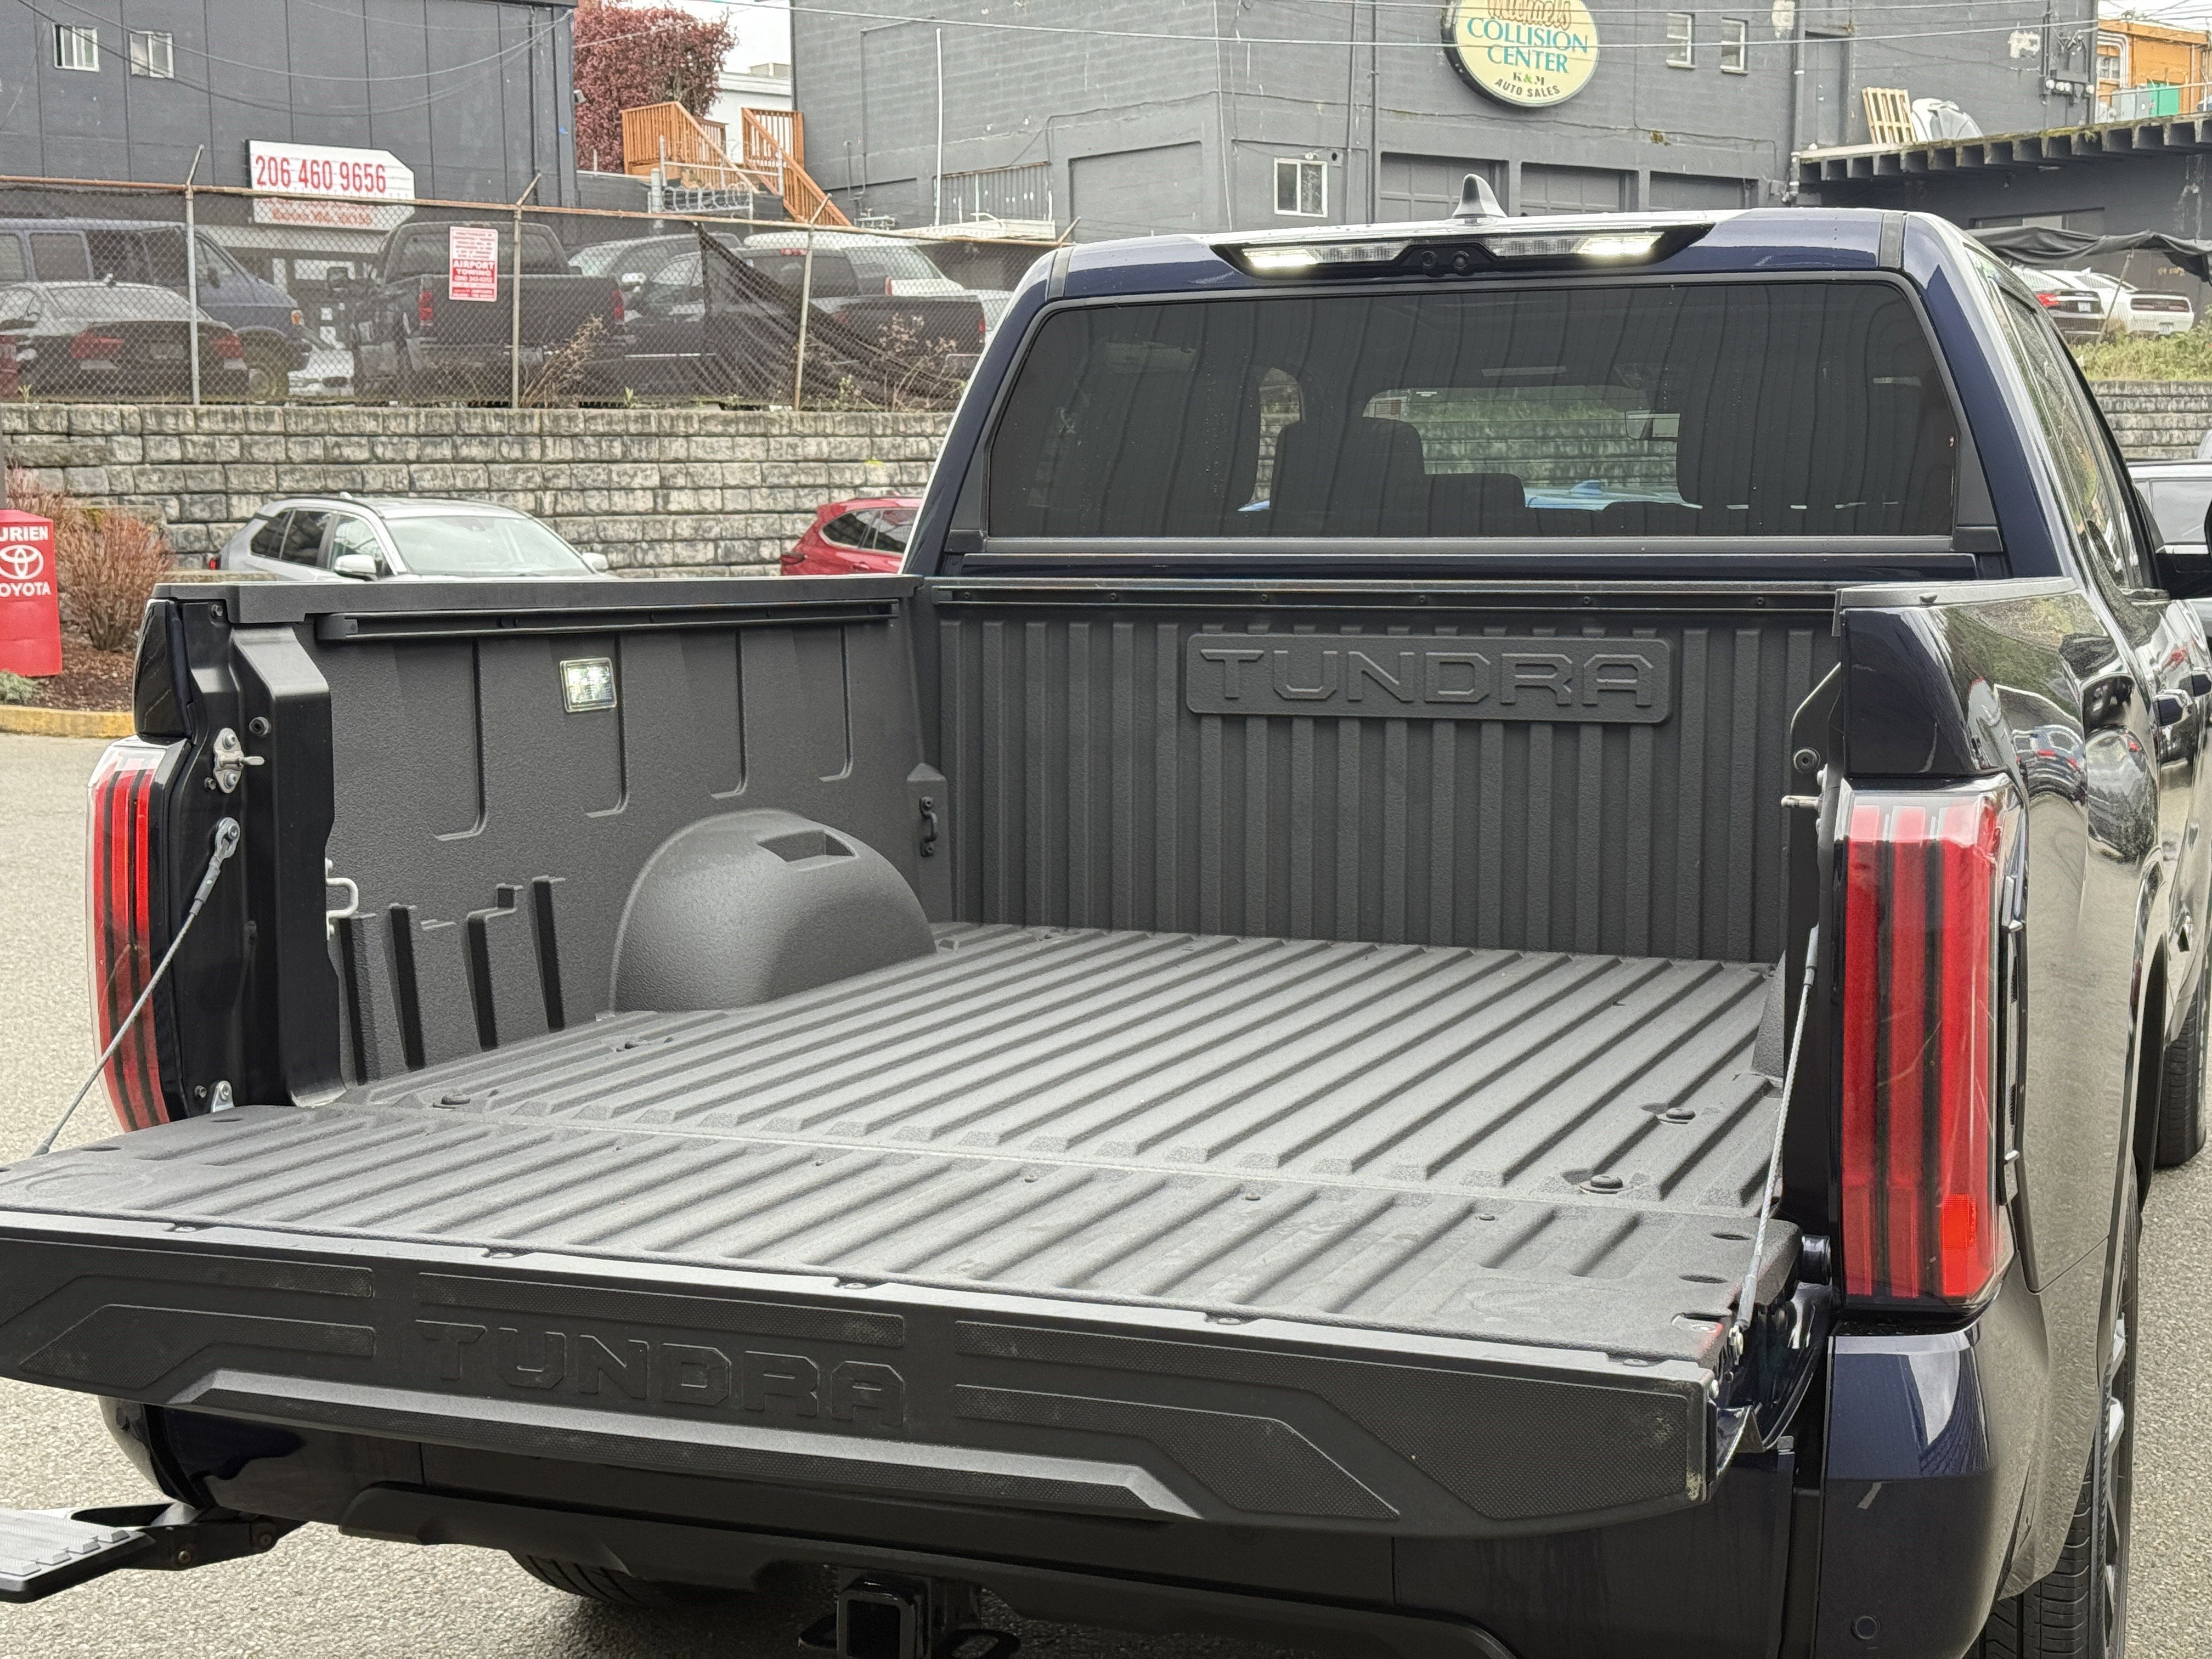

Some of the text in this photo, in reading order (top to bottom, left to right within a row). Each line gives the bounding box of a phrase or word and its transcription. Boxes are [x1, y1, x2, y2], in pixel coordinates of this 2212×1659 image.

[1466, 17, 1588, 54] COLLISION
[1487, 44, 1568, 74] CENTER
[1494, 78, 1560, 98] AUTO SALES
[256, 155, 386, 193] 206 460 9656
[453, 259, 495, 270] AIRPORT
[455, 268, 492, 276] TOWING
[1200, 648, 1654, 708] TUNDRA
[414, 1318, 906, 1426] TUNDRA
